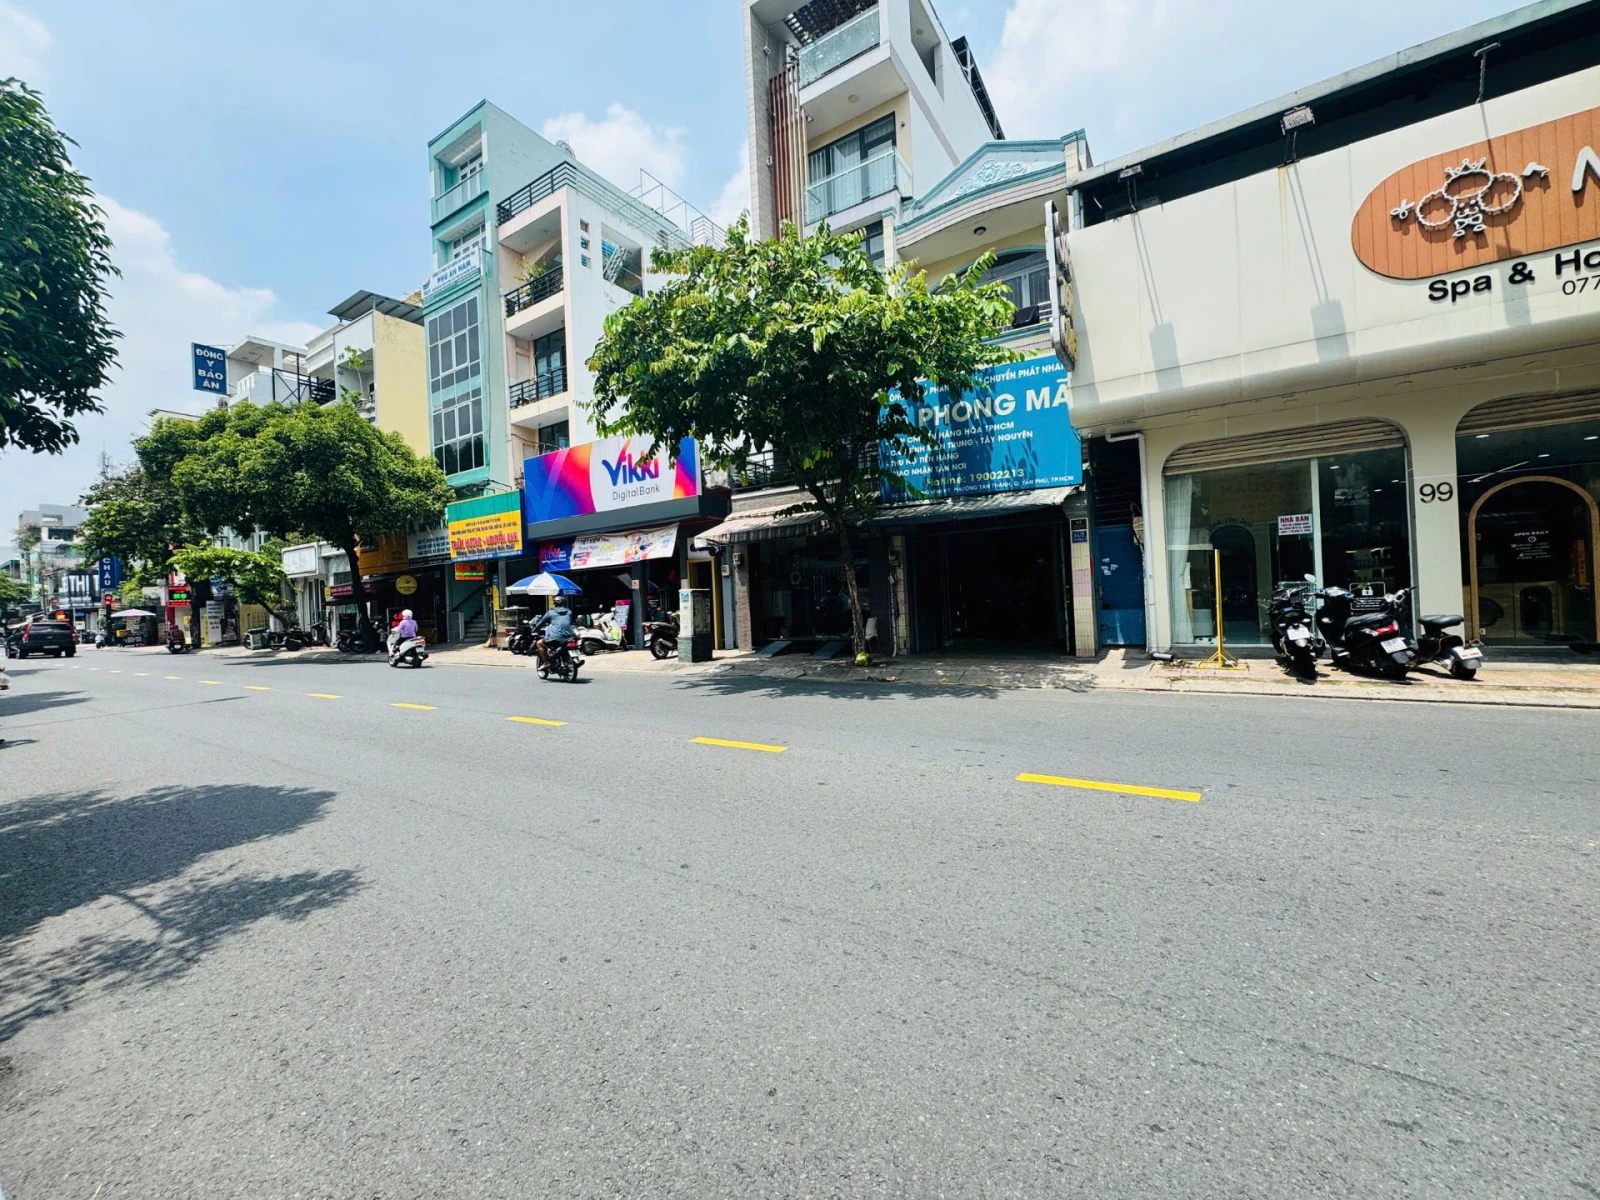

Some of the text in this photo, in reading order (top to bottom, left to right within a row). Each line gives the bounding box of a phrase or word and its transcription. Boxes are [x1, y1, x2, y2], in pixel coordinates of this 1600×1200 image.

[1428, 274, 1492, 302] Spa
[1508, 262, 1535, 285] &
[206, 359, 215, 368] Y
[984, 368, 1017, 385] CHUYỂN
[1018, 364, 1041, 379] PHÁT
[918, 393, 1016, 428] PHONG
[985, 421, 1014, 433] TPHCM
[947, 439, 973, 449] TRUNG
[981, 434, 995, 445] TÂY
[998, 430, 1033, 442] NGUYÊN
[602, 439, 660, 487] Vikki
[936, 452, 959, 462] HÀNG
[912, 466, 933, 476] NHẬN
[970, 468, 1025, 482] 19002213
[640, 484, 660, 496] Bank
[1419, 482, 1454, 504] 99
